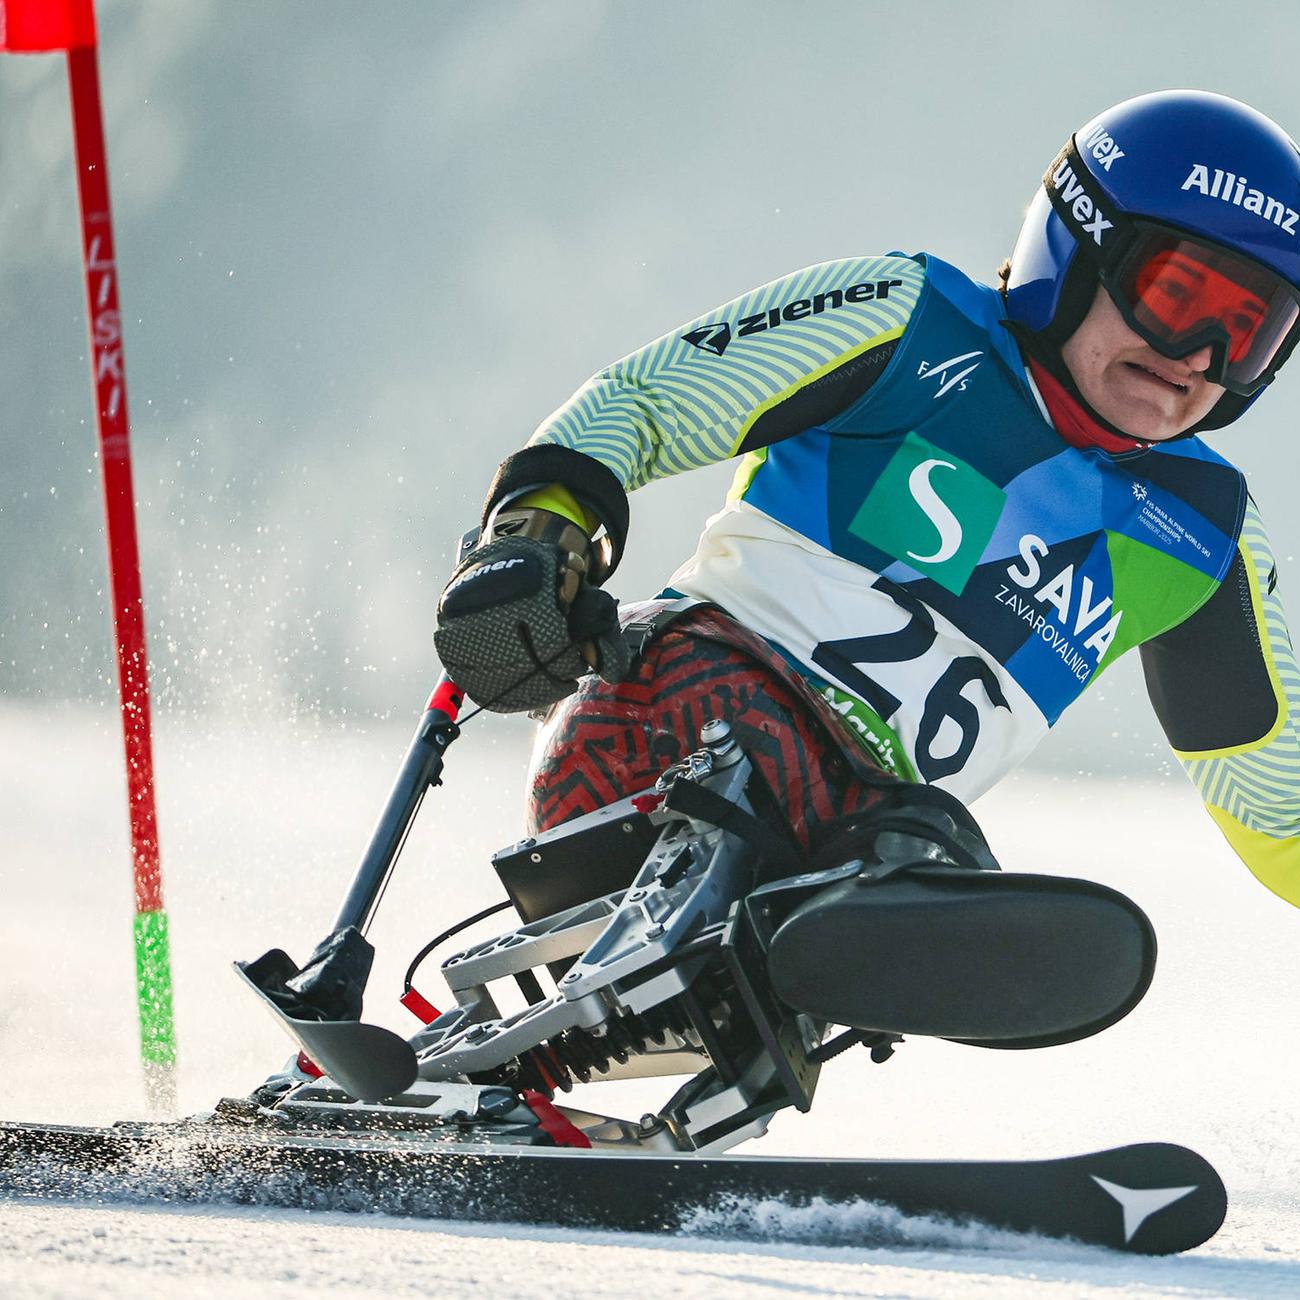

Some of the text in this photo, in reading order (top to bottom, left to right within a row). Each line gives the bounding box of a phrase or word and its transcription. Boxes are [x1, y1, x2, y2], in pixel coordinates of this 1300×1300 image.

[1052, 158, 1115, 247] uvex
[1180, 163, 1300, 236] Allianz
[87, 233, 123, 421] LISKI
[737, 278, 903, 337] ziener
[1142, 507, 1182, 542] CHAMPIONSHIPS
[1167, 518, 1185, 535] ALPINE
[1184, 532, 1202, 550] WORLD
[1201, 547, 1211, 558] SKI
[994, 584, 1092, 683] ZAVAROVALNICA
[1006, 533, 1124, 663] SAVA
[811, 576, 1013, 785] 26
